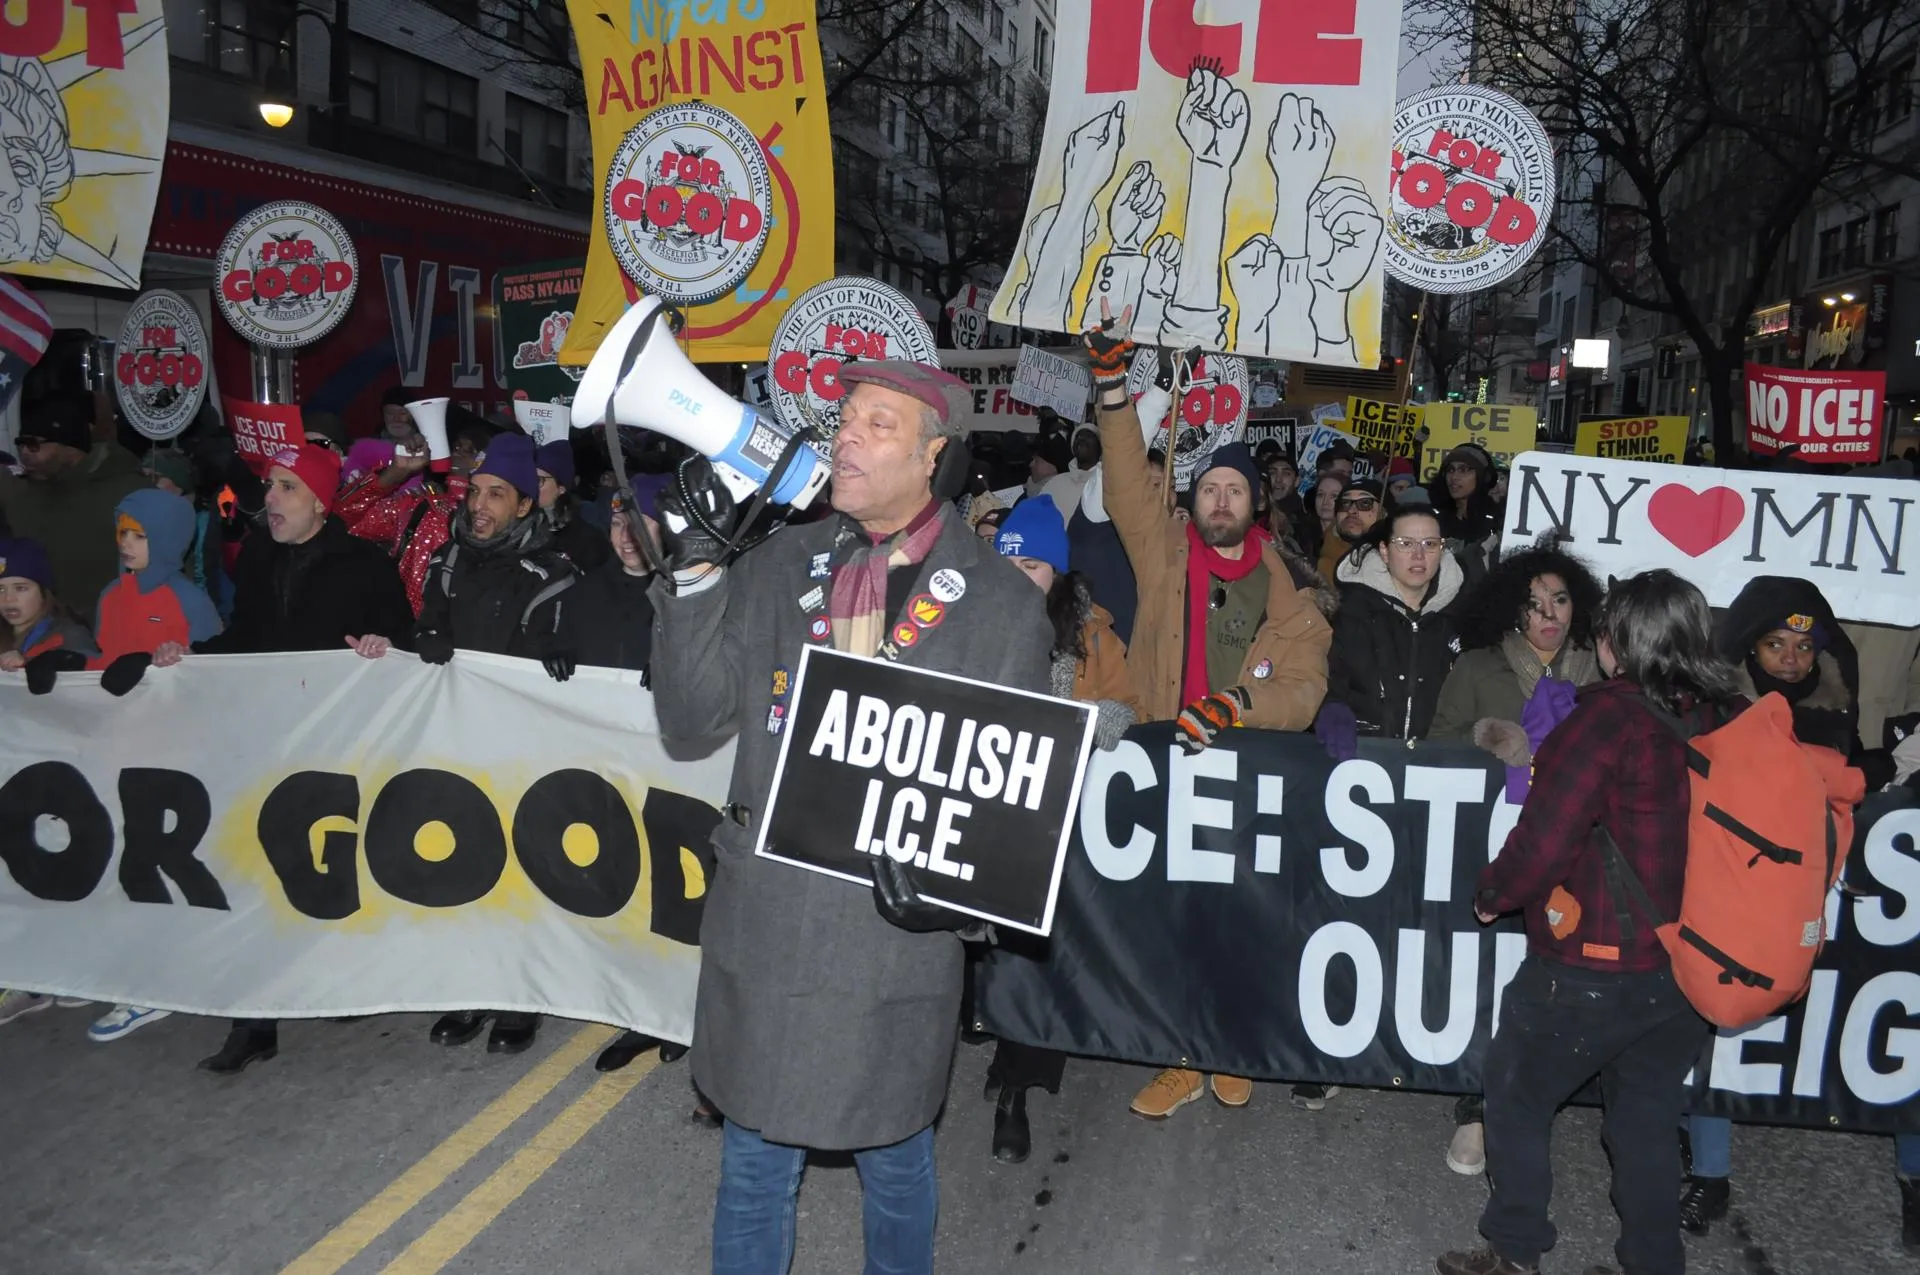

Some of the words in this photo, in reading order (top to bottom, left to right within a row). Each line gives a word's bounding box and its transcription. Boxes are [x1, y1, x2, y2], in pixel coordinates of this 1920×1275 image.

[598, 22, 807, 115] AGAINST
[1442, 120, 1461, 129] EN
[1464, 120, 1505, 145] AVANT
[616, 158, 628, 177] OF
[627, 127, 649, 153] THE
[656, 112, 698, 129] STATE
[706, 116, 724, 129] OF
[726, 128, 751, 155] NEW
[749, 154, 764, 197] YORK
[1417, 98, 1453, 117] CITY
[1457, 98, 1481, 112] OF
[1480, 99, 1544, 204] MINNEAPOLIS
[1427, 128, 1502, 180] FOR
[660, 151, 722, 187] FOR
[611, 178, 762, 243] GOOD
[230, 229, 249, 250] THE
[251, 208, 288, 228] STATE
[294, 208, 309, 217] OF
[262, 239, 314, 262] FOR
[619, 238, 651, 279] GREAT
[222, 261, 354, 303] GOOD
[1408, 263, 1437, 278] JUNE
[1461, 261, 1490, 278] 1878
[503, 282, 535, 302] PASS
[656, 276, 684, 293] THE
[784, 316, 806, 342] THE
[806, 293, 836, 317] CITY
[837, 289, 855, 303] OF
[858, 289, 928, 364] MINNEAPOLI
[830, 313, 844, 322] EN
[850, 310, 884, 327] AVANT
[959, 313, 977, 330] NO
[143, 326, 177, 348] FOR
[825, 322, 887, 361] FOR
[956, 331, 980, 350] ICE!
[117, 352, 203, 388] GOOD
[1131, 360, 1148, 386] THE
[529, 407, 554, 419] FREE
[668, 389, 703, 415] PYLE
[1354, 398, 1399, 423] ICE
[1749, 380, 1789, 434] NO
[1798, 388, 1875, 438] ICE!
[235, 415, 257, 436] ICE
[257, 420, 286, 441] OUT
[755, 424, 774, 440] RISE
[1451, 406, 1511, 433] ICE
[1599, 419, 1658, 439] STOP
[235, 433, 260, 455] FOR
[748, 433, 785, 462] RESIS
[1311, 427, 1341, 449] ICE
[1596, 436, 1659, 458] ETHNIC
[1752, 432, 1777, 448] HANDS
[1800, 443, 1828, 453] OUR
[1832, 442, 1870, 453] CITIES
[1512, 465, 1650, 545] NY
[1744, 487, 1915, 575] MN
[1000, 543, 1021, 555] UFT
[933, 575, 960, 599] OFF!
[1217, 632, 1246, 649] USMC
[809, 689, 1055, 811] ABOLISH
[1080, 739, 1284, 884] CE:
[854, 778, 974, 881] I.C.E.
[257, 767, 724, 948] GOOD
[1297, 920, 1527, 1066] OU
